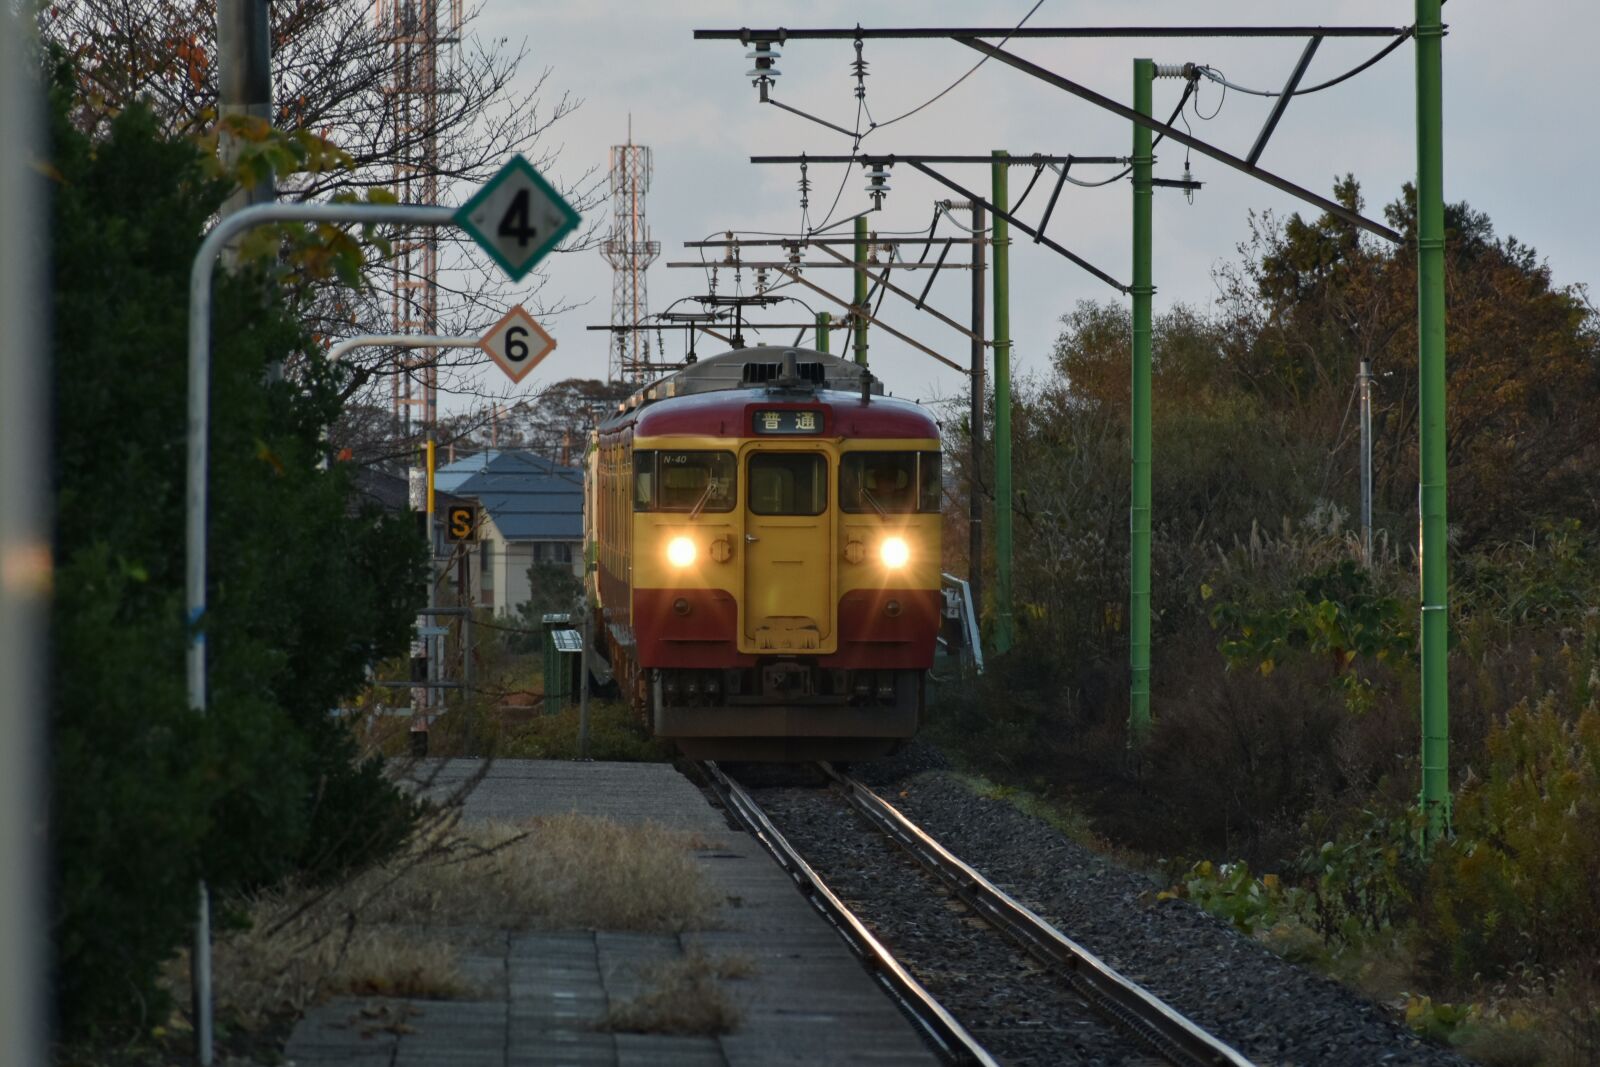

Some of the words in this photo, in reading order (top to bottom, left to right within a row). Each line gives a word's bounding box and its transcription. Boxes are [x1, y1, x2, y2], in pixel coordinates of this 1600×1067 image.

[498, 188, 536, 247] 4
[504, 326, 529, 362] 6
[762, 411, 815, 430] 普通
[452, 510, 470, 537] S
